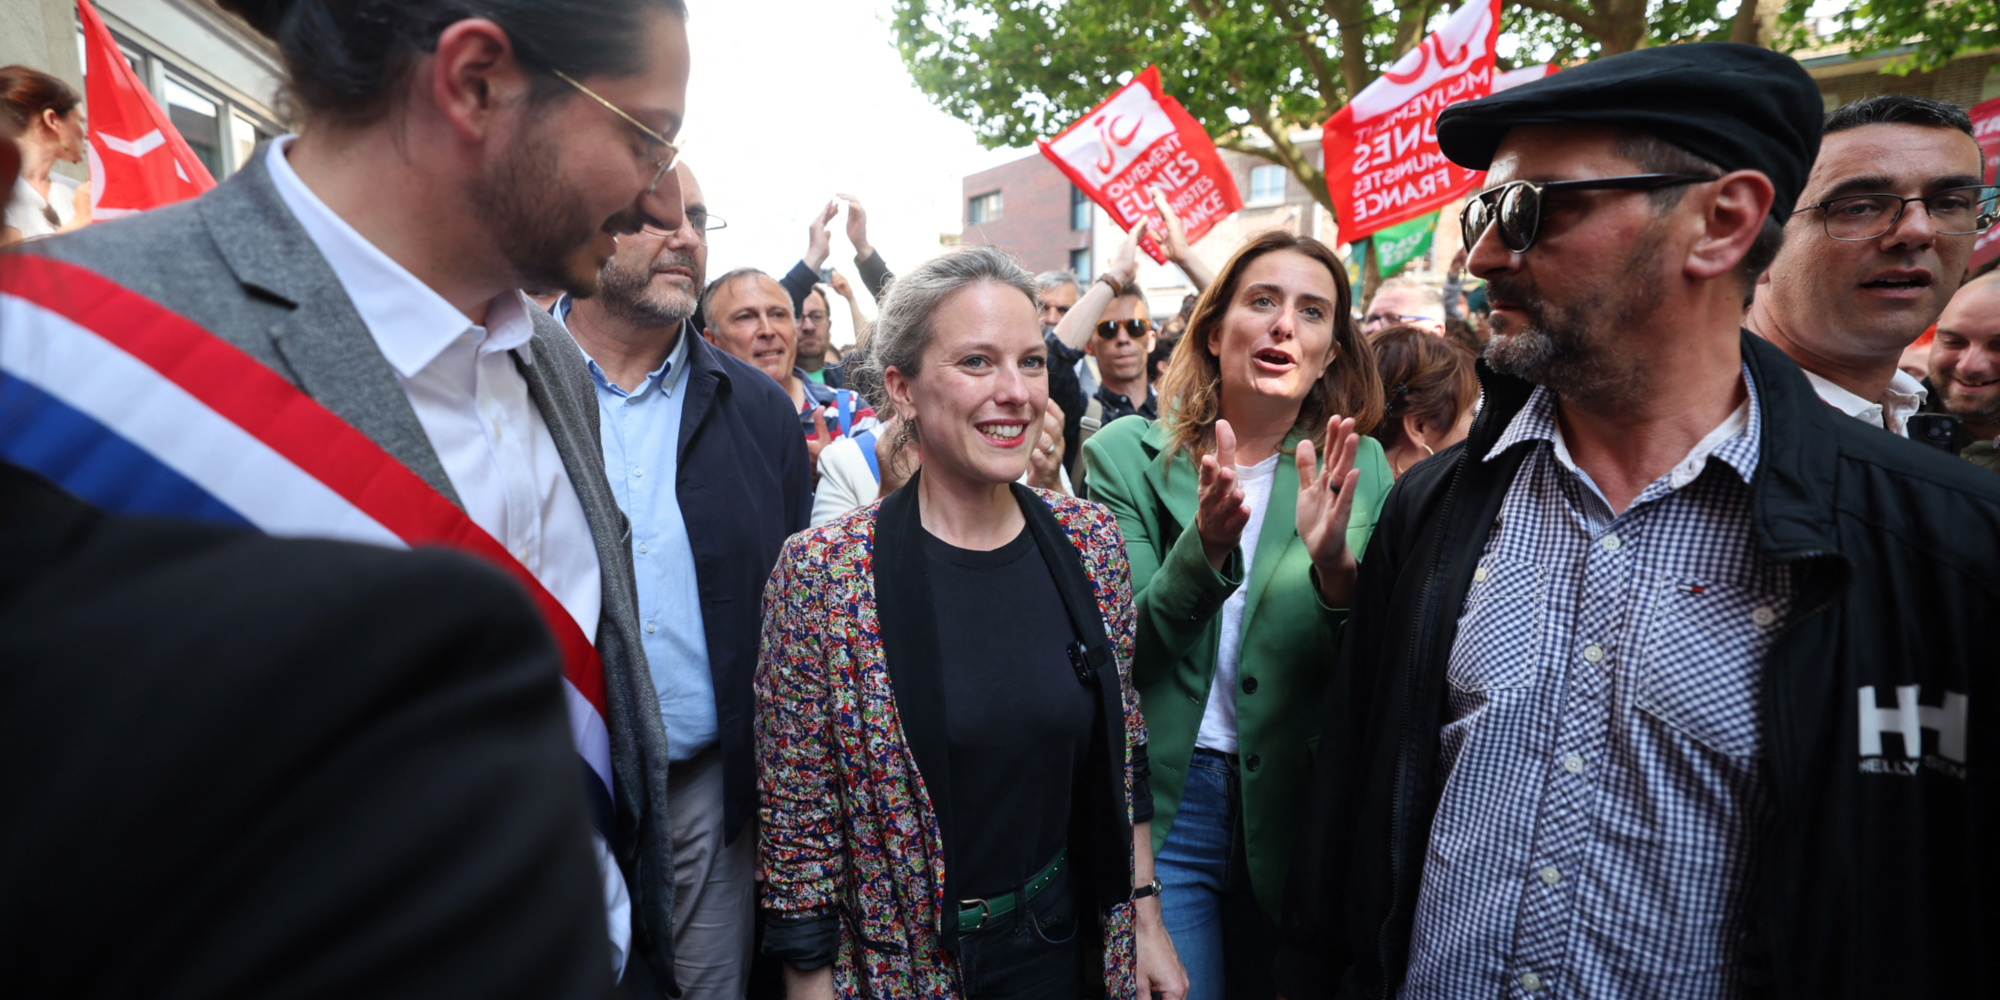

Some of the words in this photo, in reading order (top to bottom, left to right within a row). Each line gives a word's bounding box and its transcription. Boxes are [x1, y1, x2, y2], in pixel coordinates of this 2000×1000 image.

[1106, 132, 1182, 199] OUVEMENT
[1115, 150, 1200, 225] EUNES
[1160, 189, 1225, 236] ANCE
[1857, 684, 1968, 763] HH
[1858, 757, 1920, 776] HELLY
